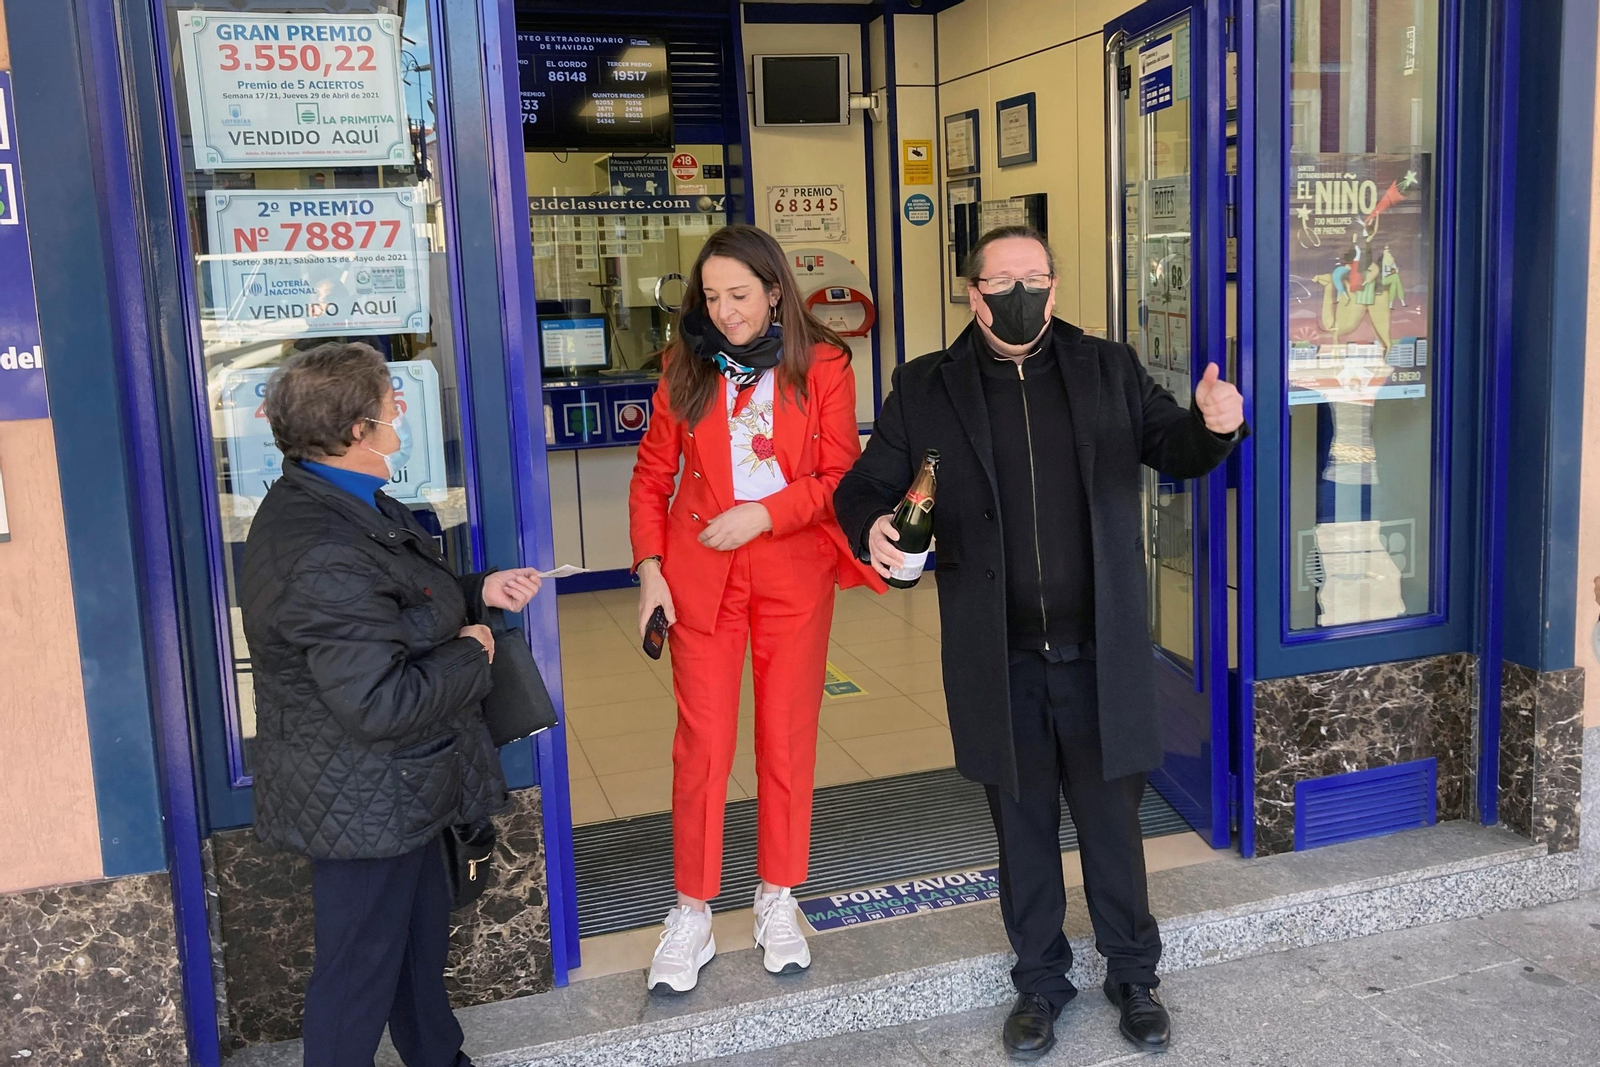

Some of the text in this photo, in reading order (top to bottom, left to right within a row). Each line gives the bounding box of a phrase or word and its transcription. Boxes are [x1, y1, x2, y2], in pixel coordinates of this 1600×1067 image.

[216, 24, 372, 42] GRAN PREMIO
[545, 36, 624, 44] EXTRAORDINARIO
[218, 43, 377, 77] 3.550,22
[548, 71, 587, 82] 86148
[613, 71, 647, 81] 19517
[237, 80, 364, 90] Premio de 5 ACIERTOS
[520, 100, 539, 110] 33
[323, 115, 395, 124] LA PRIMITIVA
[522, 113, 537, 124] 79
[228, 125, 379, 146] VENDIDO AQUÍ
[677, 156, 692, 165] +18
[794, 187, 833, 197] PREMIO
[1297, 173, 1378, 215] EL NIÑO
[258, 199, 374, 217] 2º PREMIO
[530, 198, 691, 211] eldelasuerte.com
[1326, 217, 1352, 225] MILLONES
[233, 220, 401, 252] Nº 78877
[263, 258, 291, 266] 38/21,
[352, 255, 373, 264] Mayo
[271, 279, 310, 287] LOTERÍA
[269, 288, 318, 296] NACIONAL
[249, 296, 397, 320] VENDIDO AQUÍ
[0, 345, 43, 370] del
[1391, 371, 1421, 382] 6 ENERO
[828, 871, 996, 908] POR FAVOR,
[806, 880, 999, 923] MANTENGA LA DISTA
